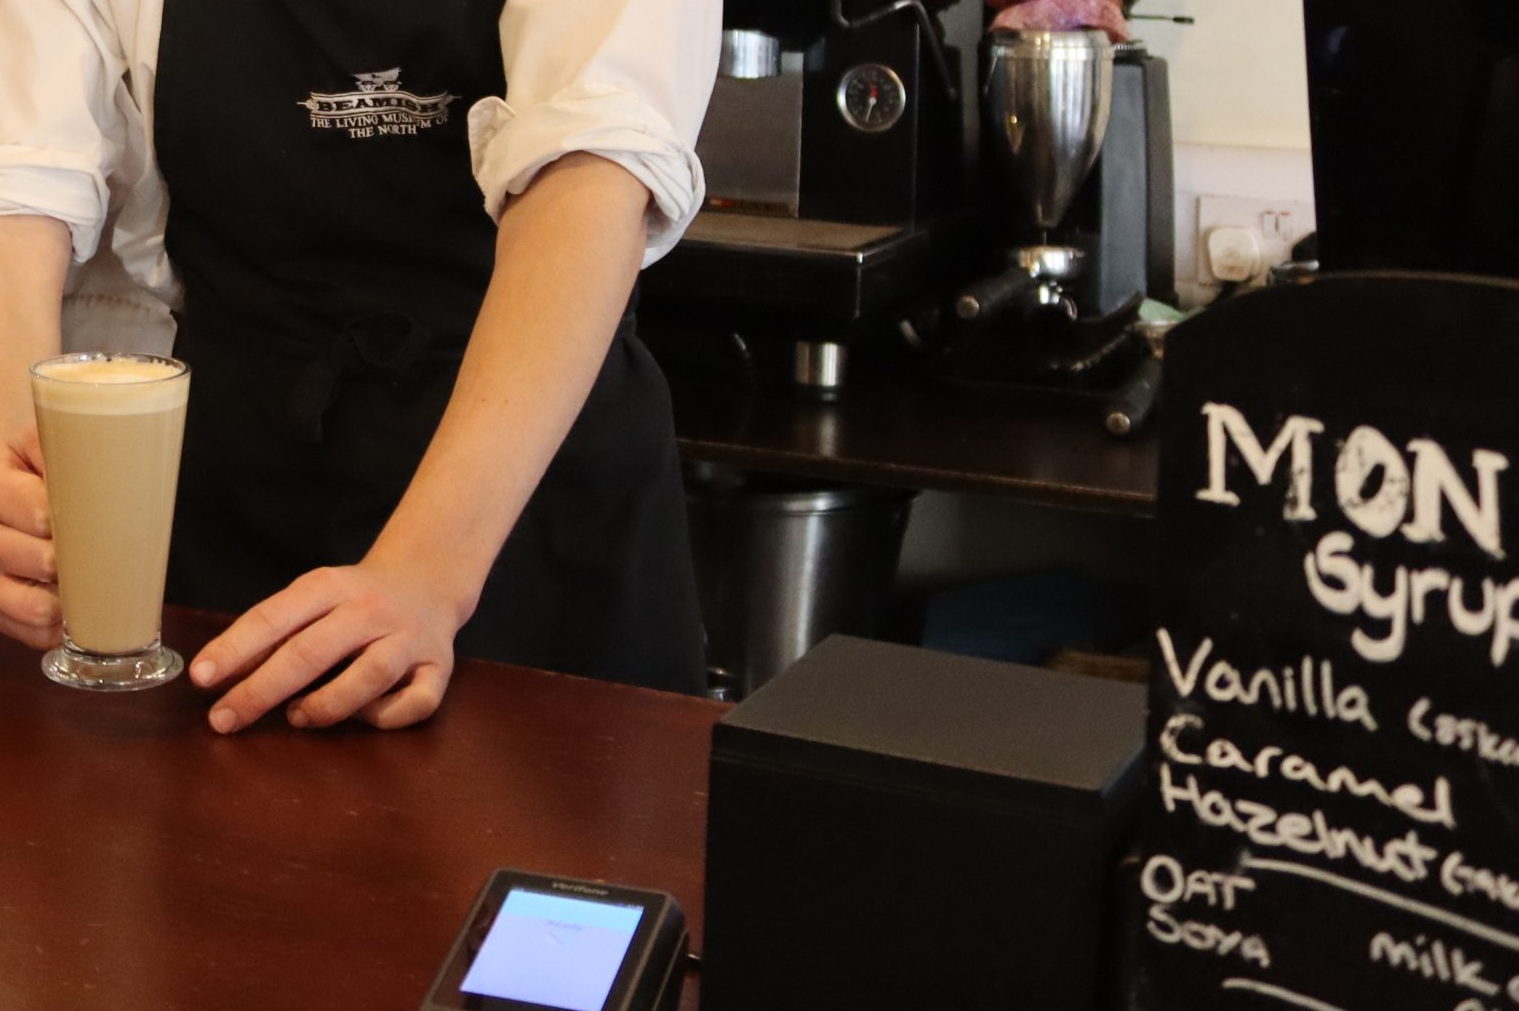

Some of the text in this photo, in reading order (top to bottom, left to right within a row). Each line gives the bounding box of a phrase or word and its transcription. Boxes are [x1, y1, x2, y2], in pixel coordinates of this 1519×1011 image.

[311, 118, 331, 128] THE
[336, 114, 378, 128] LIVING
[349, 125, 417, 138] THE NORTH
[1156, 627, 1378, 731] Vanilla
[1160, 714, 1456, 830] Caramel
[1160, 762, 1437, 882] Hazelnut
[1370, 932, 1499, 996] milk
